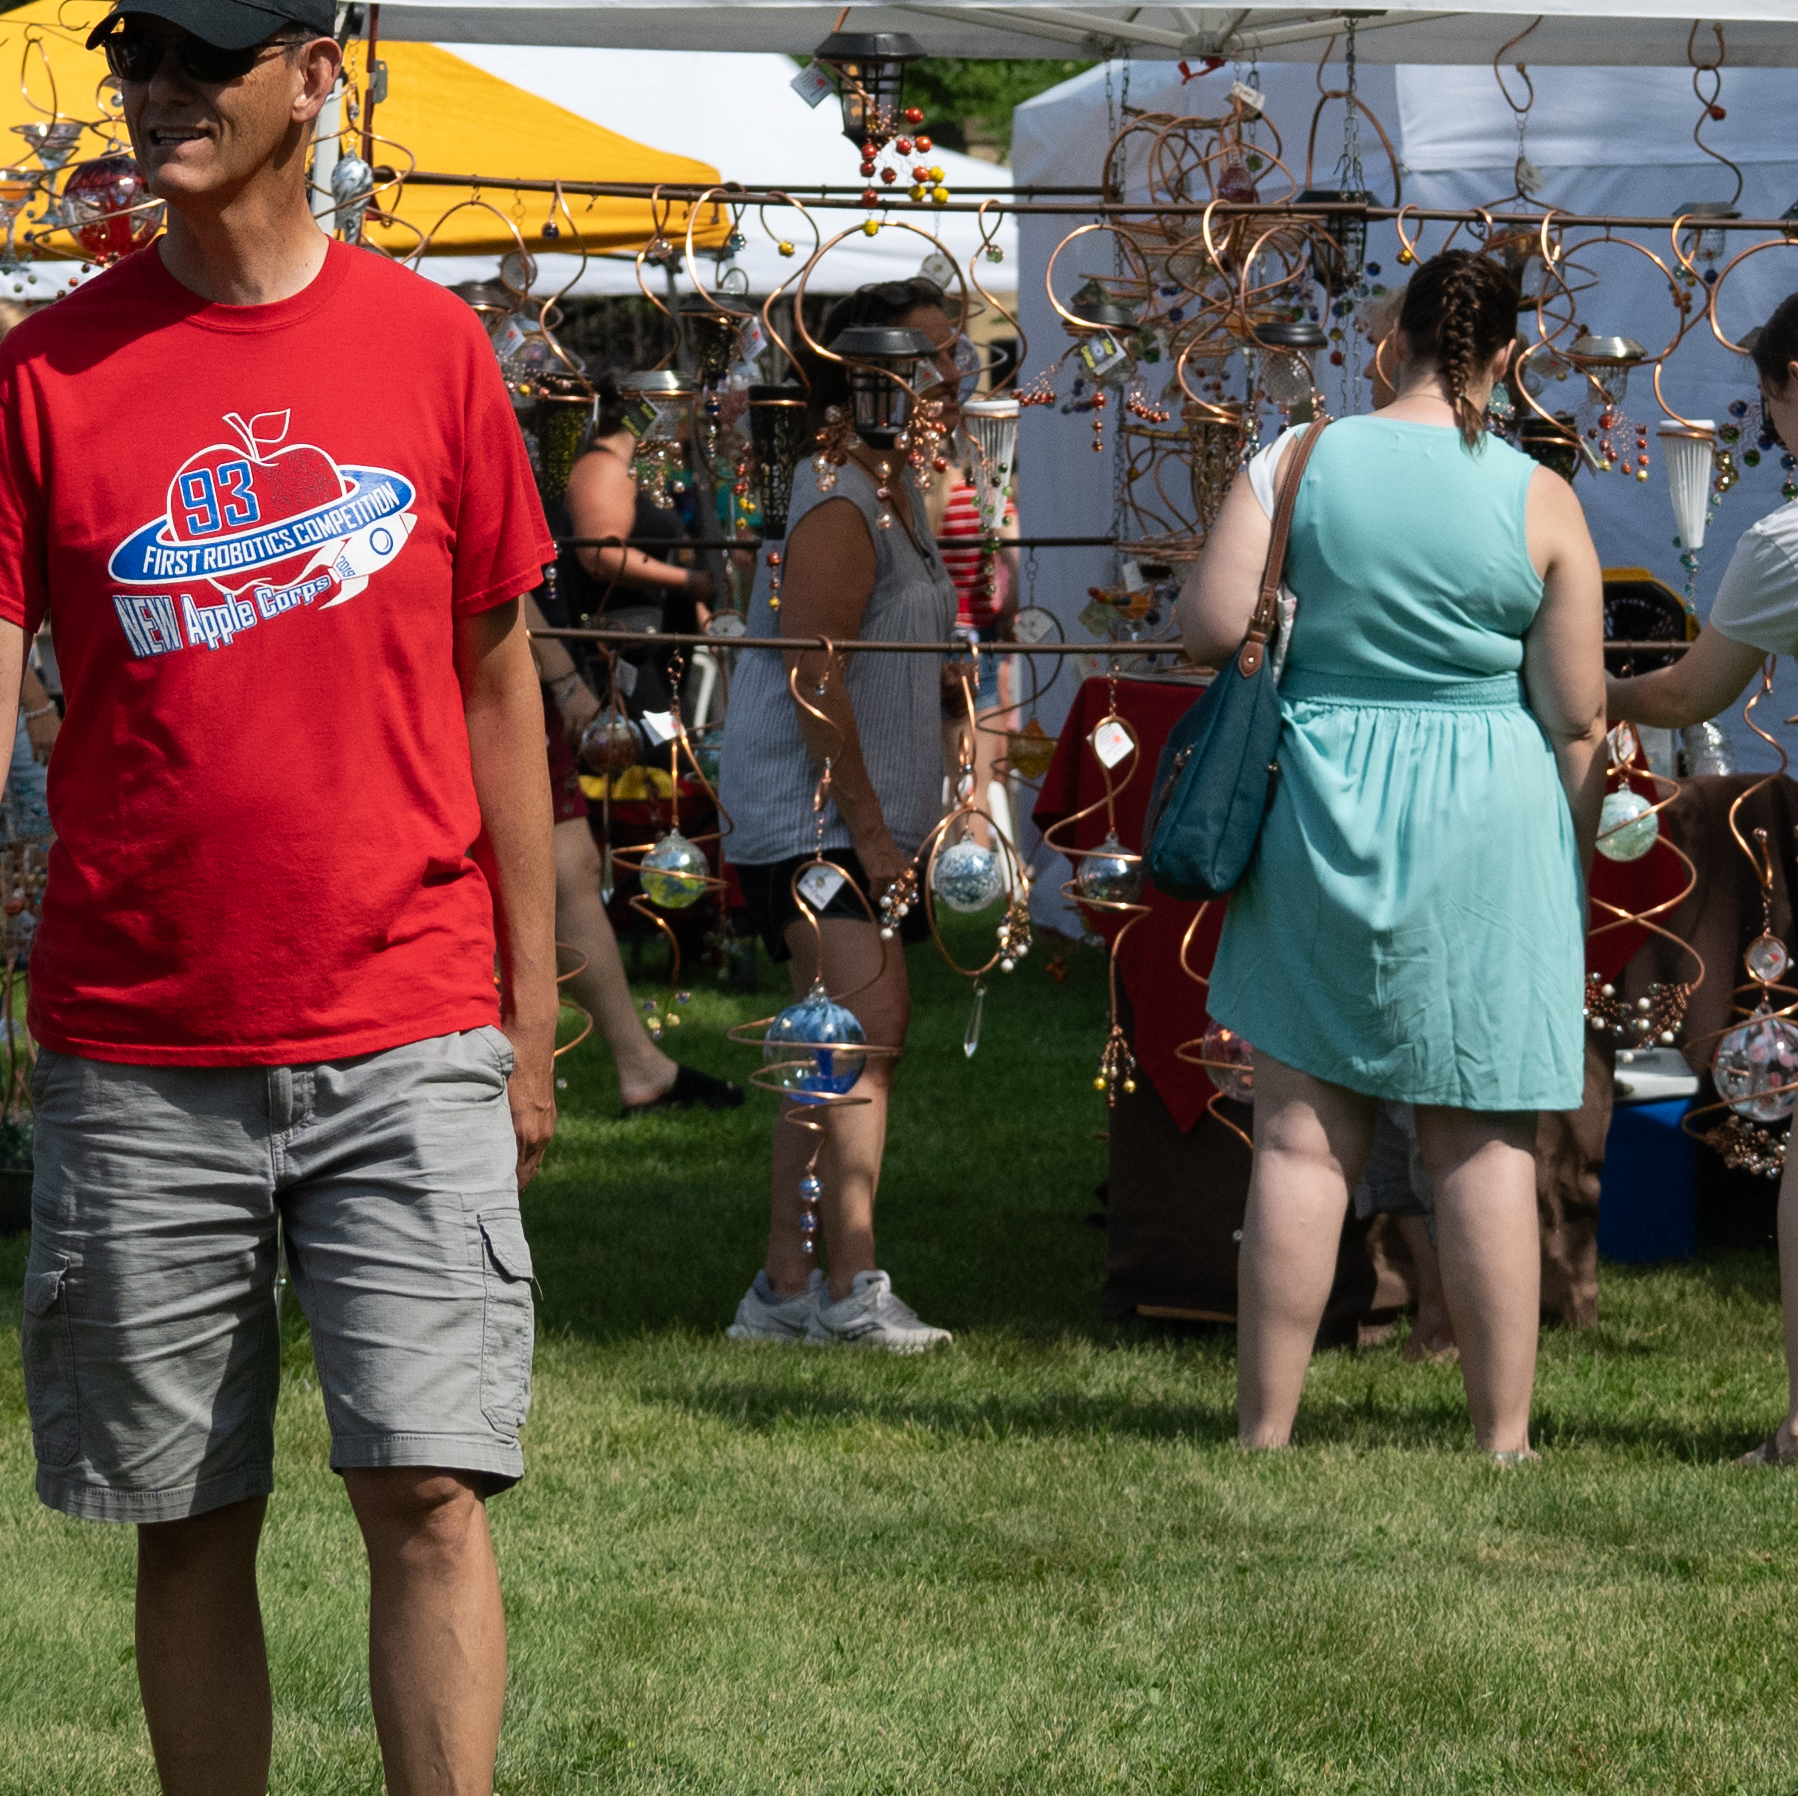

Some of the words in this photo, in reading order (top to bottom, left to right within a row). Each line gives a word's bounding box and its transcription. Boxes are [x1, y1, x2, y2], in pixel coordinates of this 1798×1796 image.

[142, 545, 201, 575] FIRST
[203, 530, 296, 570] ROBOTICS
[297, 483, 401, 545] COMPETITION
[179, 459, 261, 535] 93
[336, 555, 356, 577] 2019
[113, 595, 183, 658] NEW
[181, 593, 257, 651] Apple
[254, 575, 331, 620] Corps
